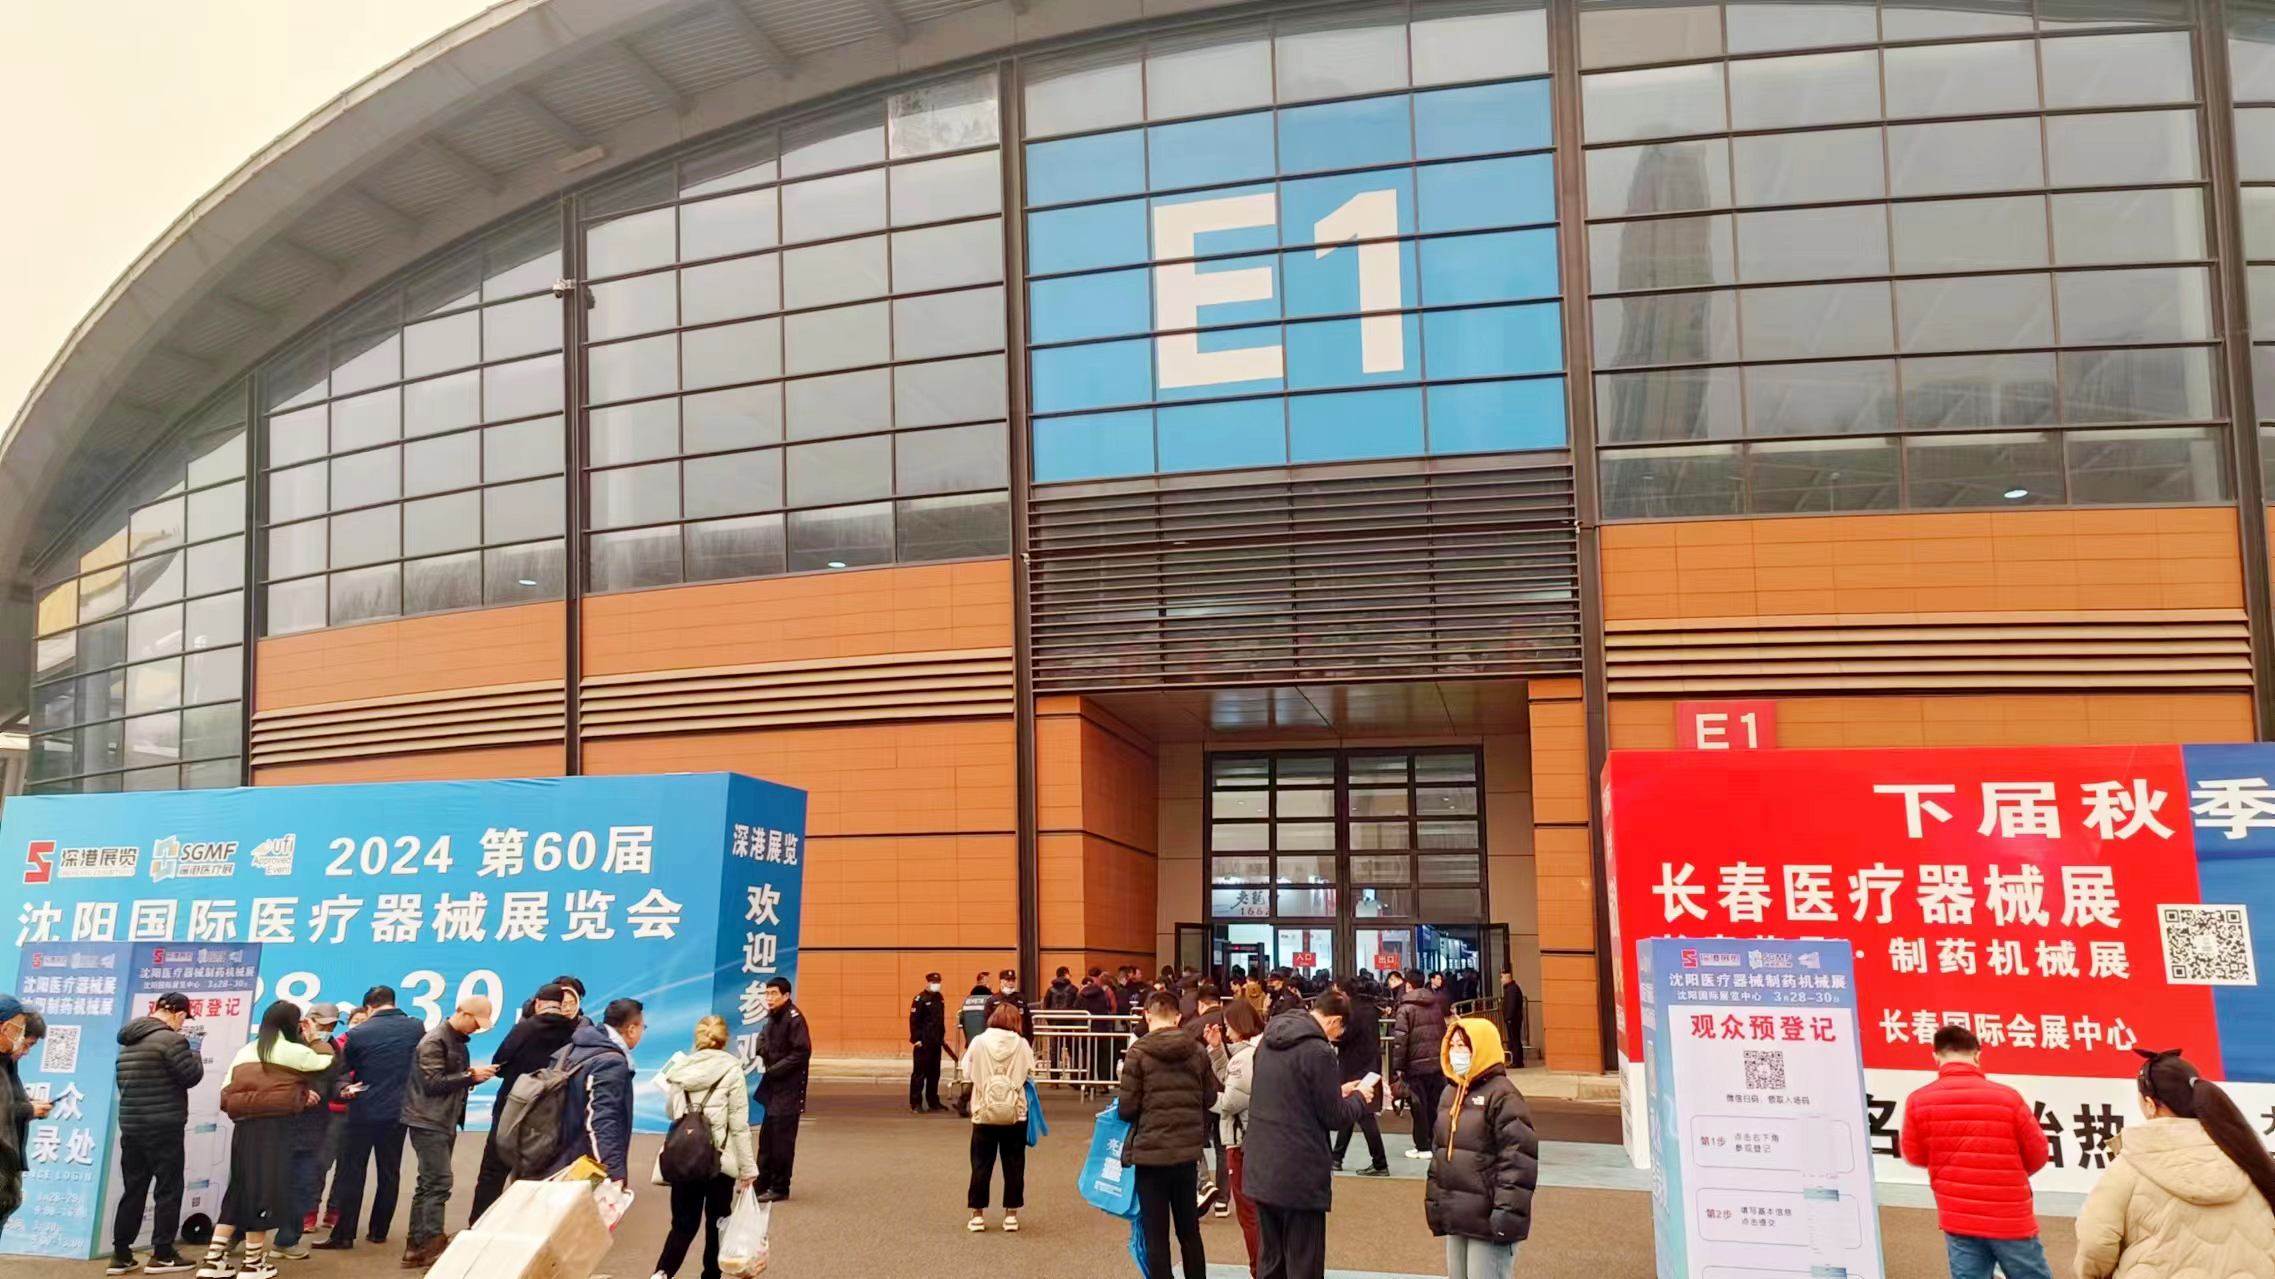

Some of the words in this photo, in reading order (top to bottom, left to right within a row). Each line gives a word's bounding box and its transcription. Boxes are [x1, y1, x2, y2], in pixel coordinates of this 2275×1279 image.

[1154, 188, 1404, 389] E1
[1695, 713, 1758, 749] E1
[1873, 778, 2275, 840] 下届秋季
[59, 847, 138, 868] 深港展览
[180, 842, 237, 861] SGMF
[325, 836, 454, 876] 2024
[476, 825, 654, 878] 第60届
[733, 824, 799, 866] 深港展览
[1652, 861, 2122, 929] 长春医疗器械展
[15, 887, 683, 948] 沈阳国际医疗器械展览会
[1296, 953, 1312, 961] 入口
[1378, 955, 1395, 964] 出口
[1889, 937, 2130, 980] 制药机械展
[24, 976, 118, 995] 沈阳医疗器械展
[736, 883, 781, 1074] 欢迎参观
[1669, 973, 1848, 989] 沈阳医疗器械制药机械展
[1677, 991, 1762, 1002] 沈阳国际展览中心
[1691, 1014, 1836, 1042] 观众预登记
[1879, 1009, 2137, 1052] 长春国际会展中心
[1700, 1136, 1726, 1147] 第1步
[1706, 1208, 1733, 1220] 第2步
